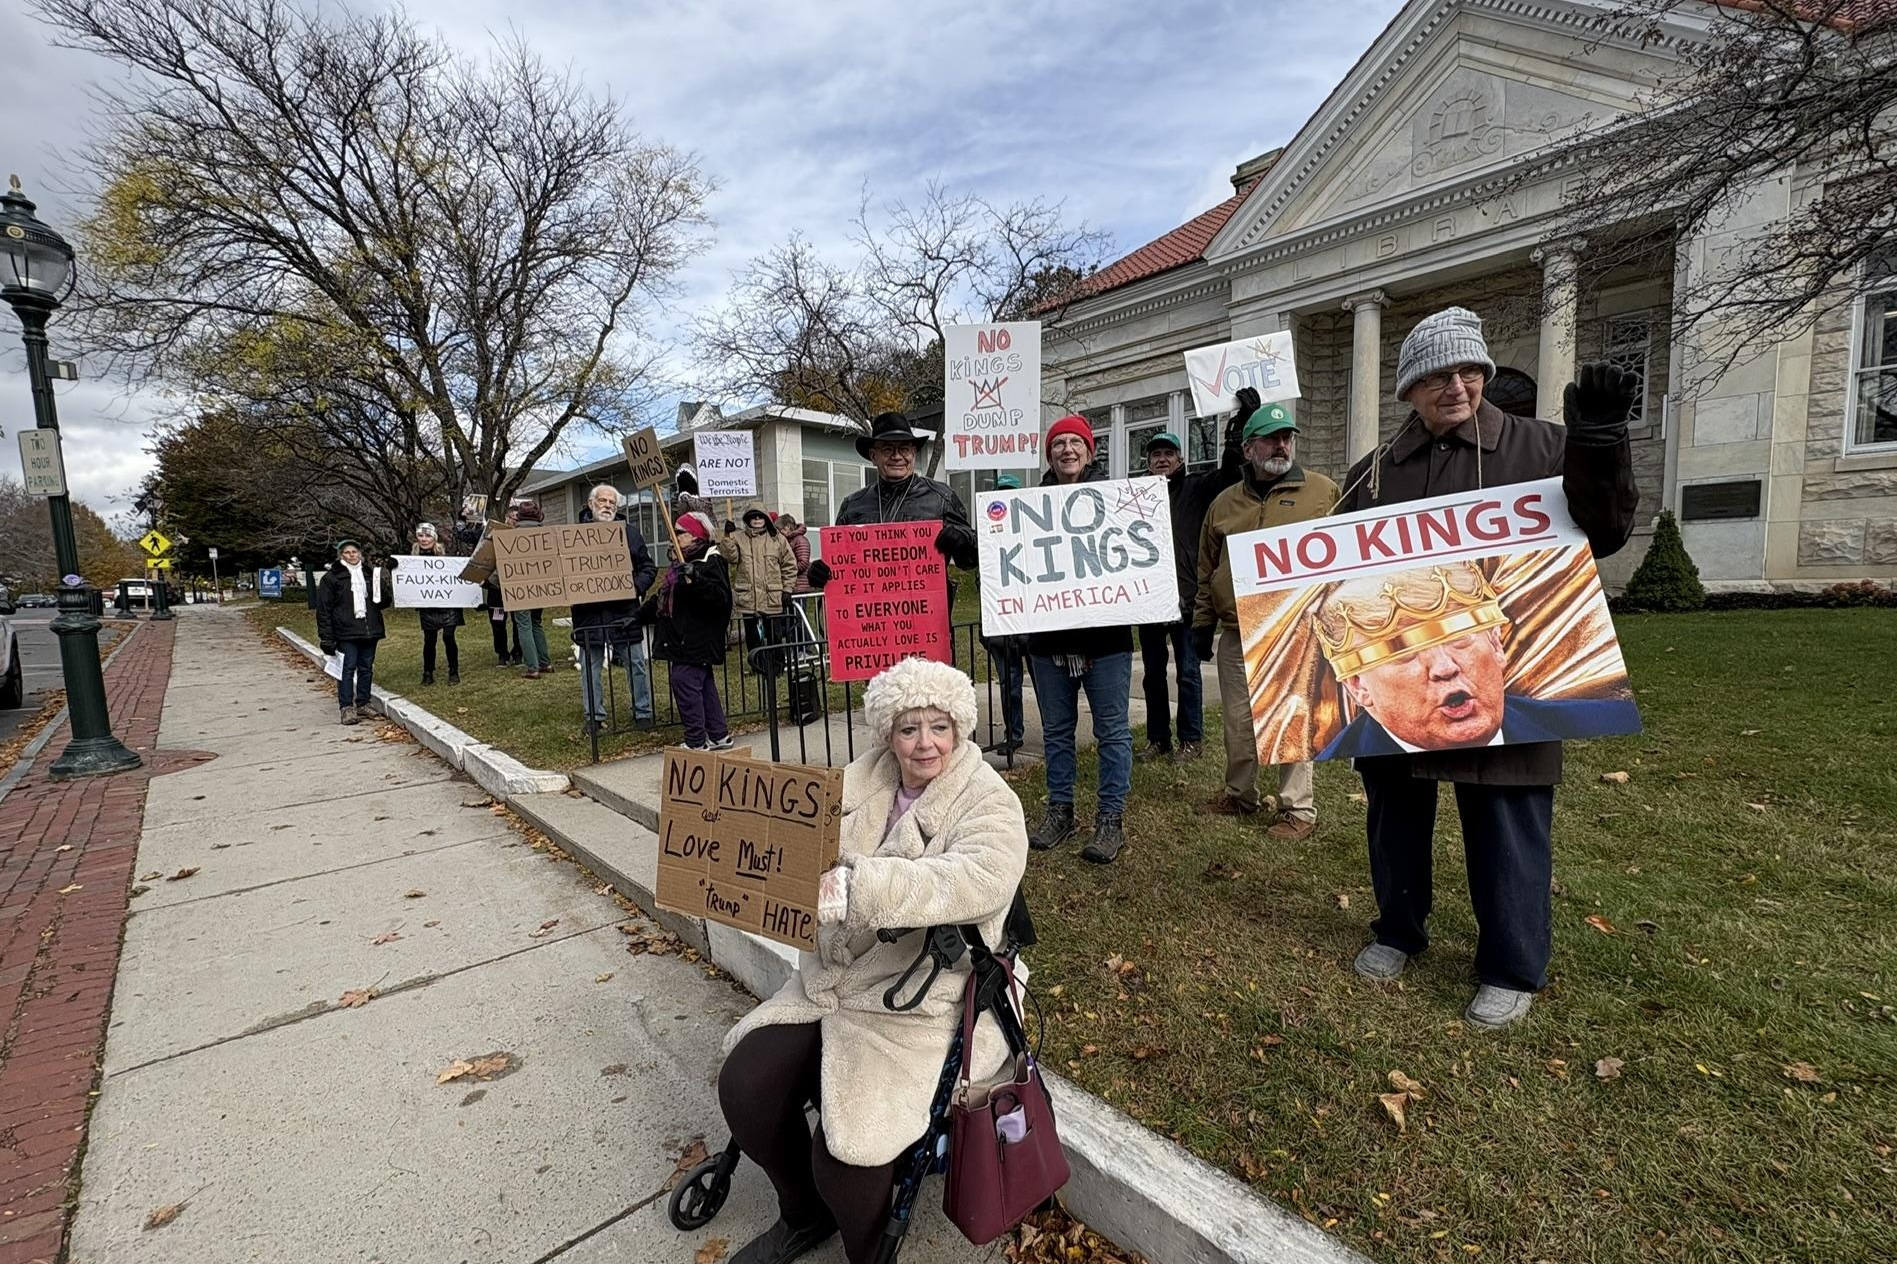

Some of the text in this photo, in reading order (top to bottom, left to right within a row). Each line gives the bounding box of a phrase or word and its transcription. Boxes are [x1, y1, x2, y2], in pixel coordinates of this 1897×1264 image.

[1292, 177, 1586, 282] LIBRAR
[978, 328, 1011, 354] NO
[1194, 346, 1281, 397] VOTE
[963, 408, 1024, 431] DUMP
[30, 438, 46, 451] TWO
[629, 436, 649, 460] NO
[698, 434, 712, 445] We
[722, 433, 749, 448] People
[952, 432, 1039, 459] TRUMP!
[31, 456, 50, 469] HOUR
[631, 455, 664, 484] KINGS
[699, 457, 752, 469] ARE NOT
[28, 474, 60, 487] PARKING
[707, 479, 749, 488] Domestic
[709, 487, 750, 496] Terrorists
[1010, 487, 1106, 535] NO
[498, 525, 624, 555] VOTE EARLY!
[830, 527, 932, 544] IF YOU THINK YOU
[1253, 494, 1552, 579] NO KINGS
[831, 545, 933, 566] LOVE FREEDOM,
[999, 519, 1160, 587] KINGS
[423, 559, 445, 570] NO
[503, 553, 626, 579] DUMP TRUMP
[852, 567, 871, 579] YOU
[877, 564, 909, 578] DON'T
[915, 563, 940, 576] CARE
[420, 589, 453, 600] WAY
[504, 573, 634, 602] NO KINGS OR CROOKS
[843, 579, 926, 595] IF IT APPLIES
[836, 599, 934, 620] TO EVERYONE,
[997, 596, 1024, 616] IN
[861, 619, 913, 633] WHAT YOU
[837, 632, 938, 650] ACTUALLY LOVE IS
[668, 757, 706, 796] NO
